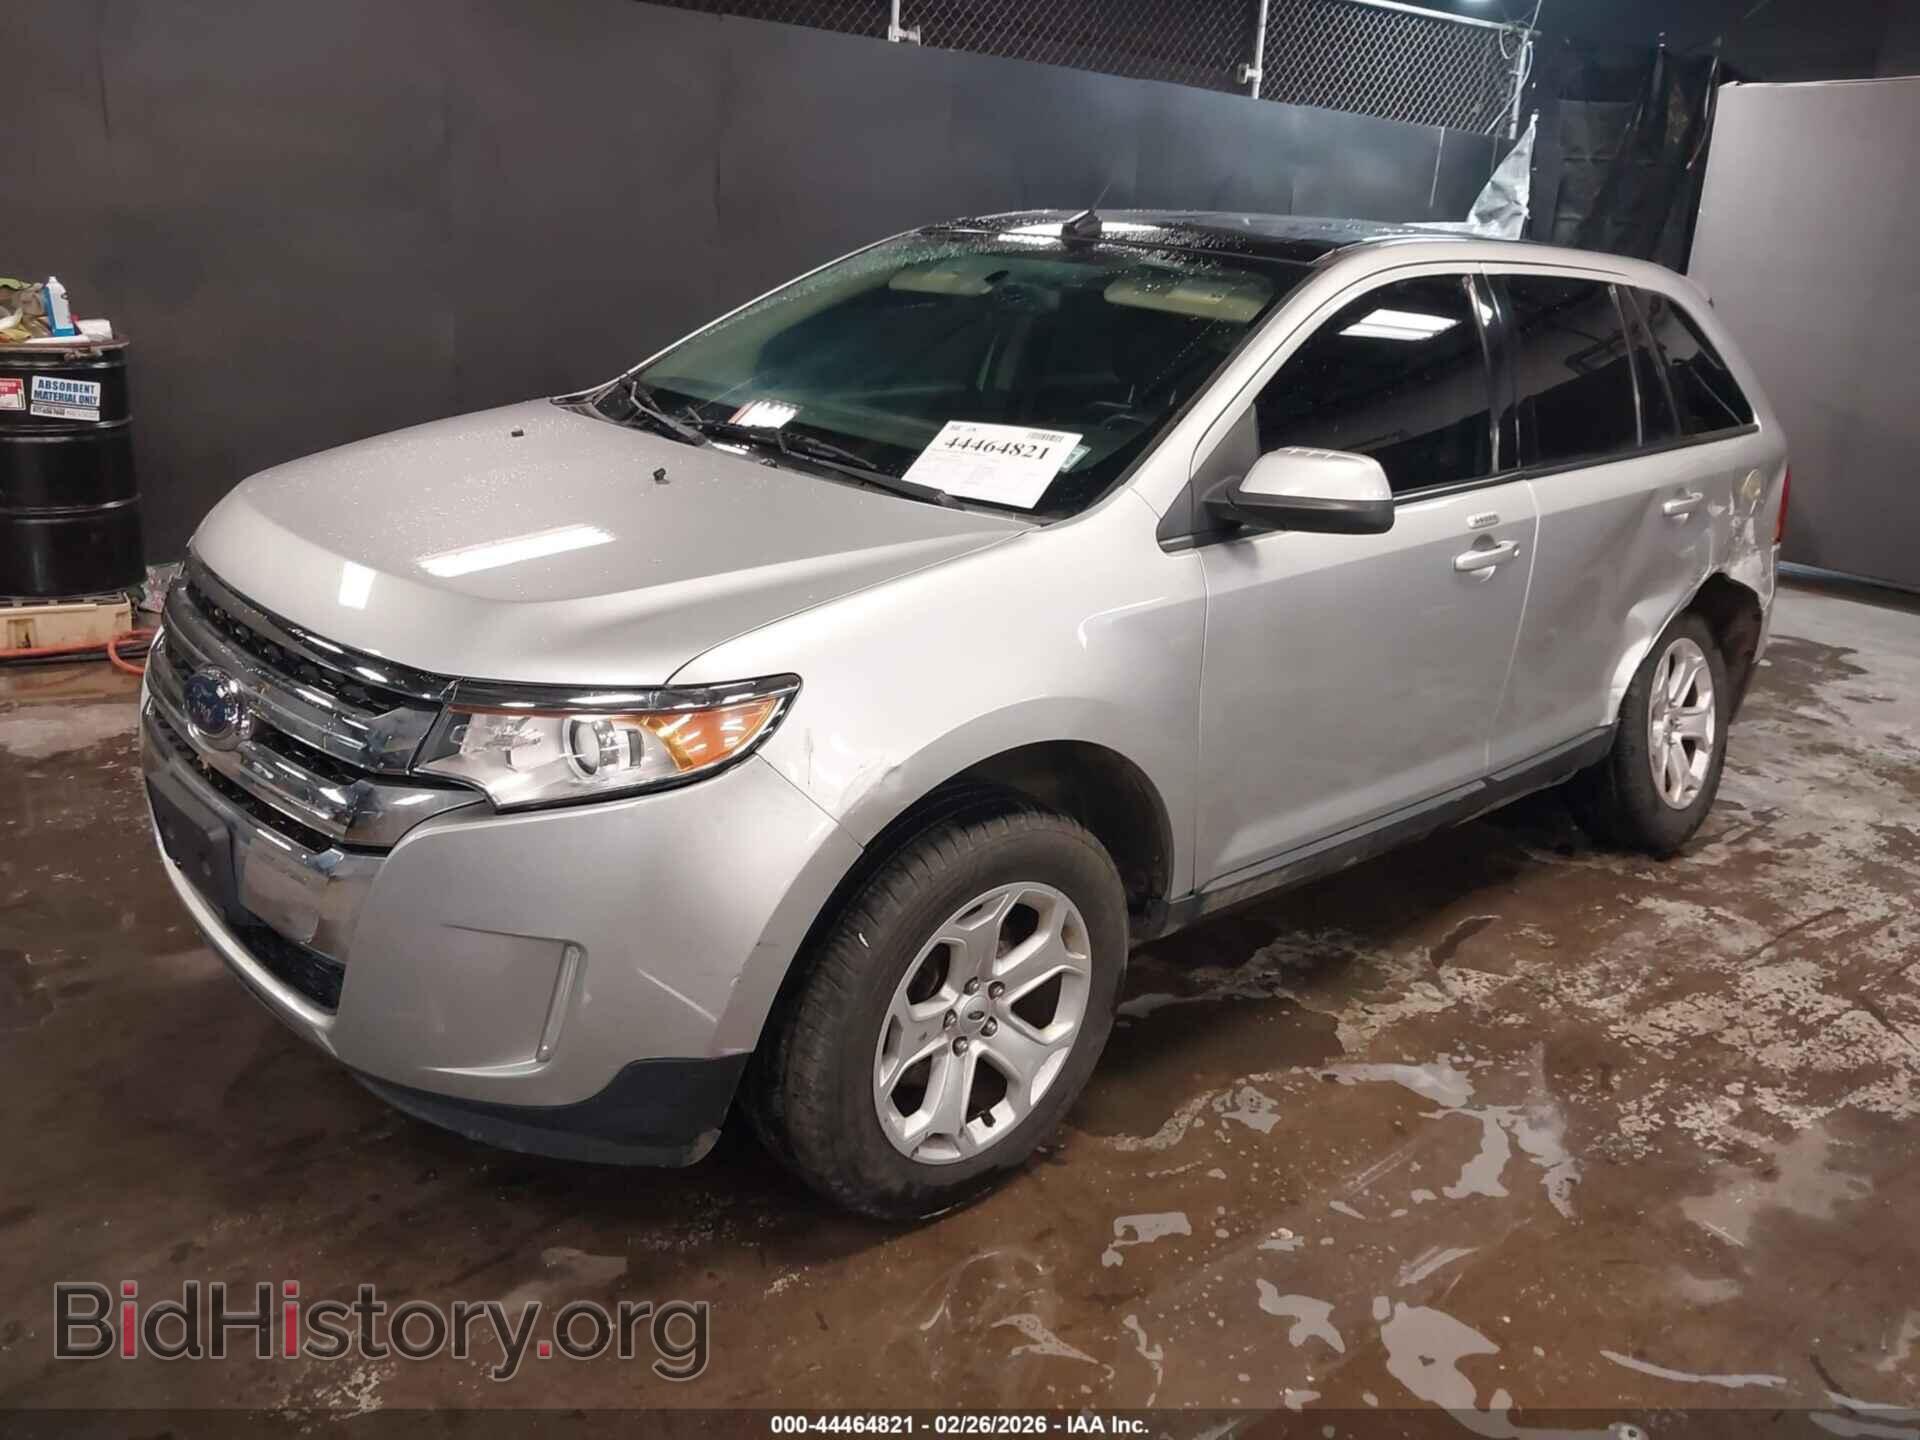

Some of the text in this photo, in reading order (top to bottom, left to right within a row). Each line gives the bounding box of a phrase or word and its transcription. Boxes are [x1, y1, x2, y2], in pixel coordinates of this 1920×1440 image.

[38, 379, 96, 394] ABSORBENT
[33, 390, 98, 405] MATERIAL ONLY
[944, 436, 1051, 460] 44464821
